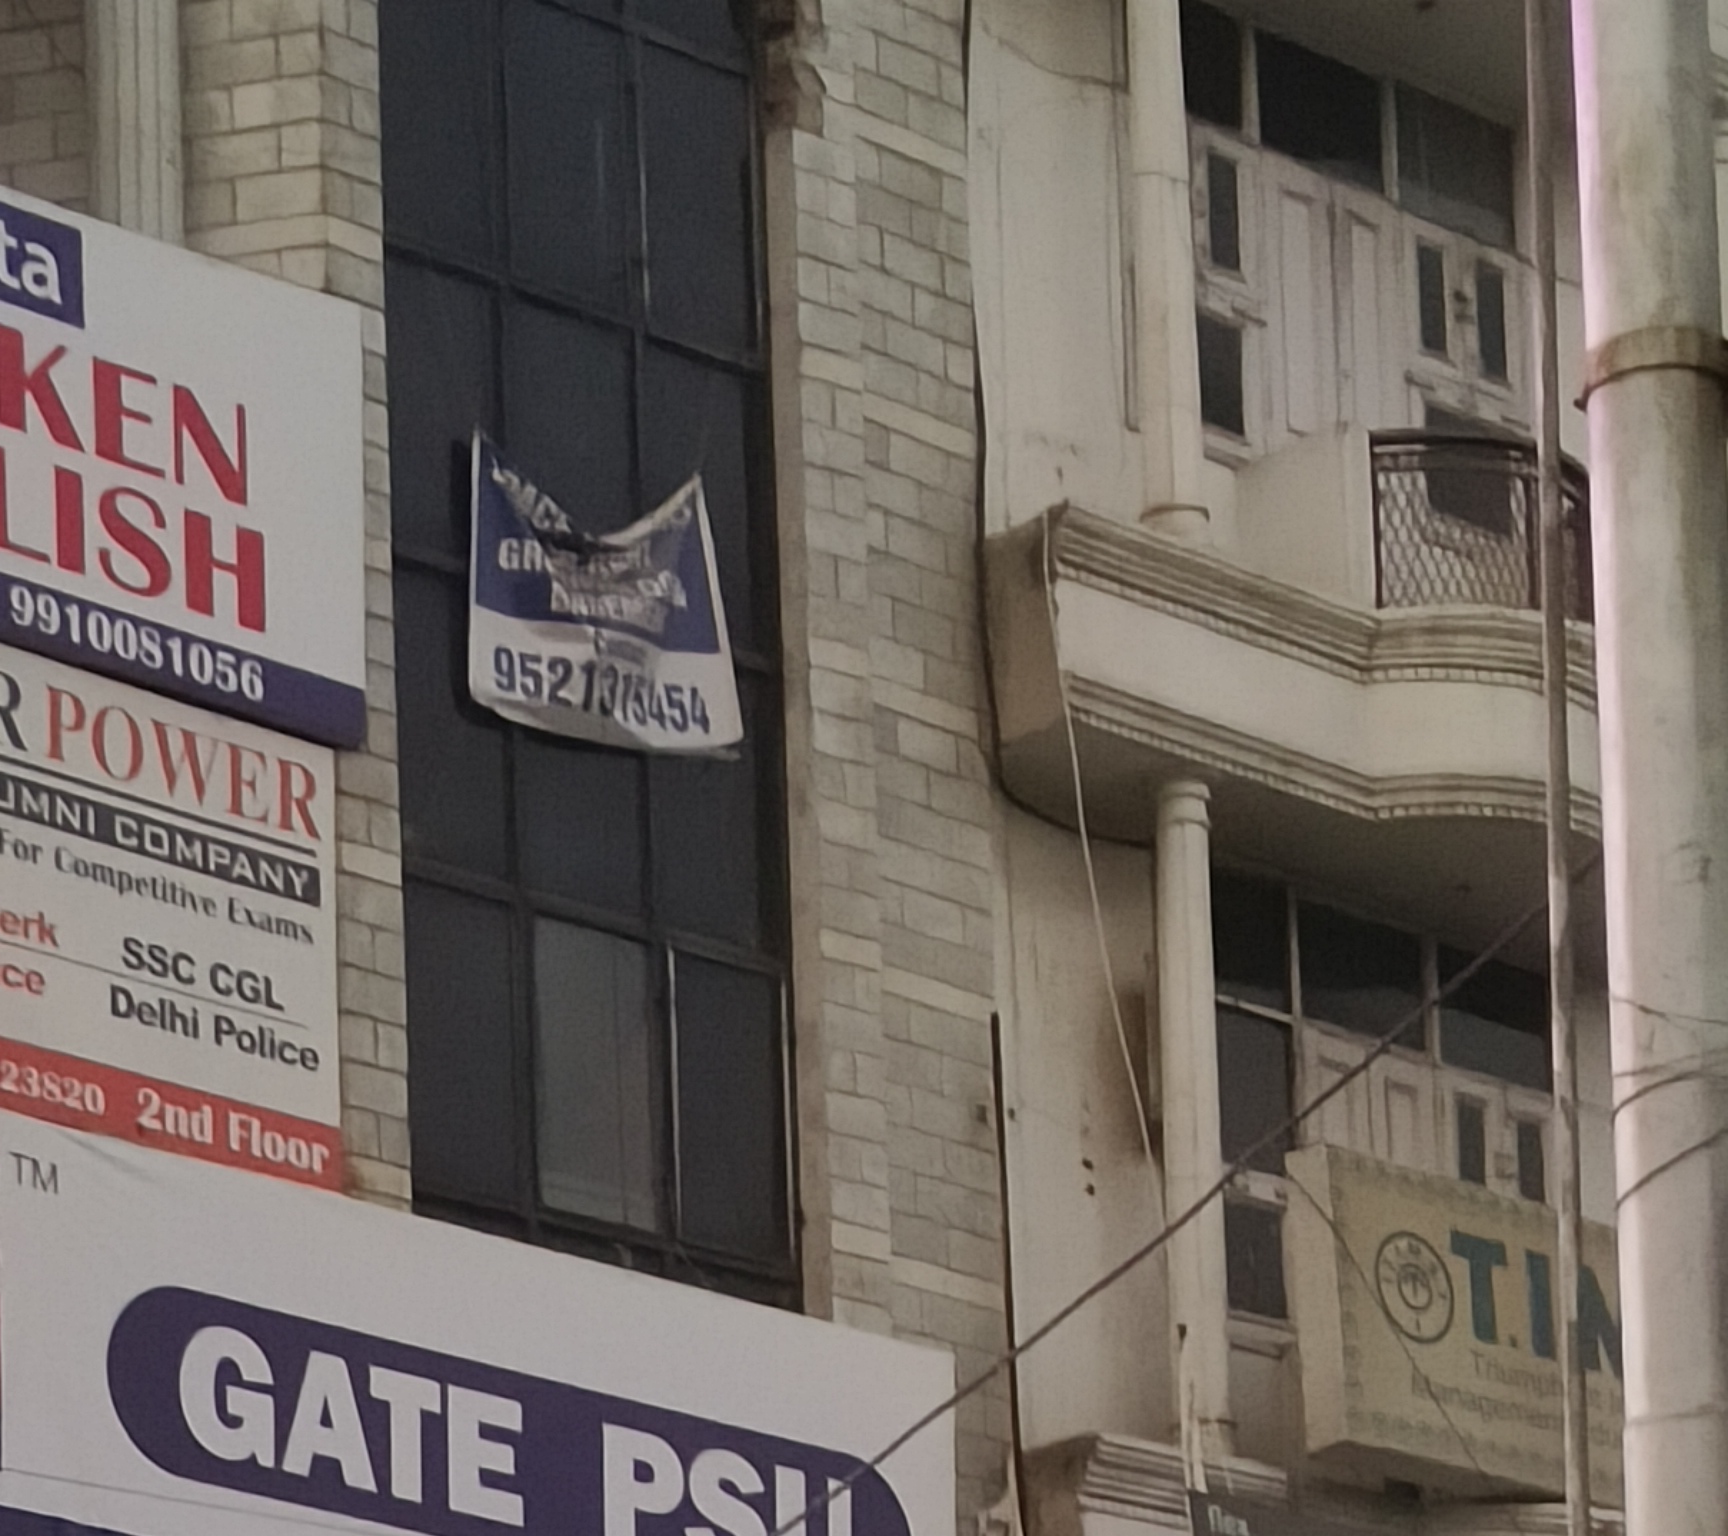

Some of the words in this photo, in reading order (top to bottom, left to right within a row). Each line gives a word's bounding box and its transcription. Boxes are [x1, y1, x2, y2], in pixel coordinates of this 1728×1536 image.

[10, 584, 267, 702] 9910081056
[45, 685, 321, 842] POWER
[55, 847, 218, 922] Competitive
[228, 901, 315, 945] Exams
[114, 814, 313, 902] COMPANY
[121, 936, 196, 987] SSC
[208, 963, 284, 1012] CGL
[108, 984, 200, 1041] Delhi
[215, 1014, 320, 1073] Police
[136, 1087, 213, 1146] 2nd
[228, 1109, 331, 1176] Floor
[178, 1324, 524, 1529] GATE
